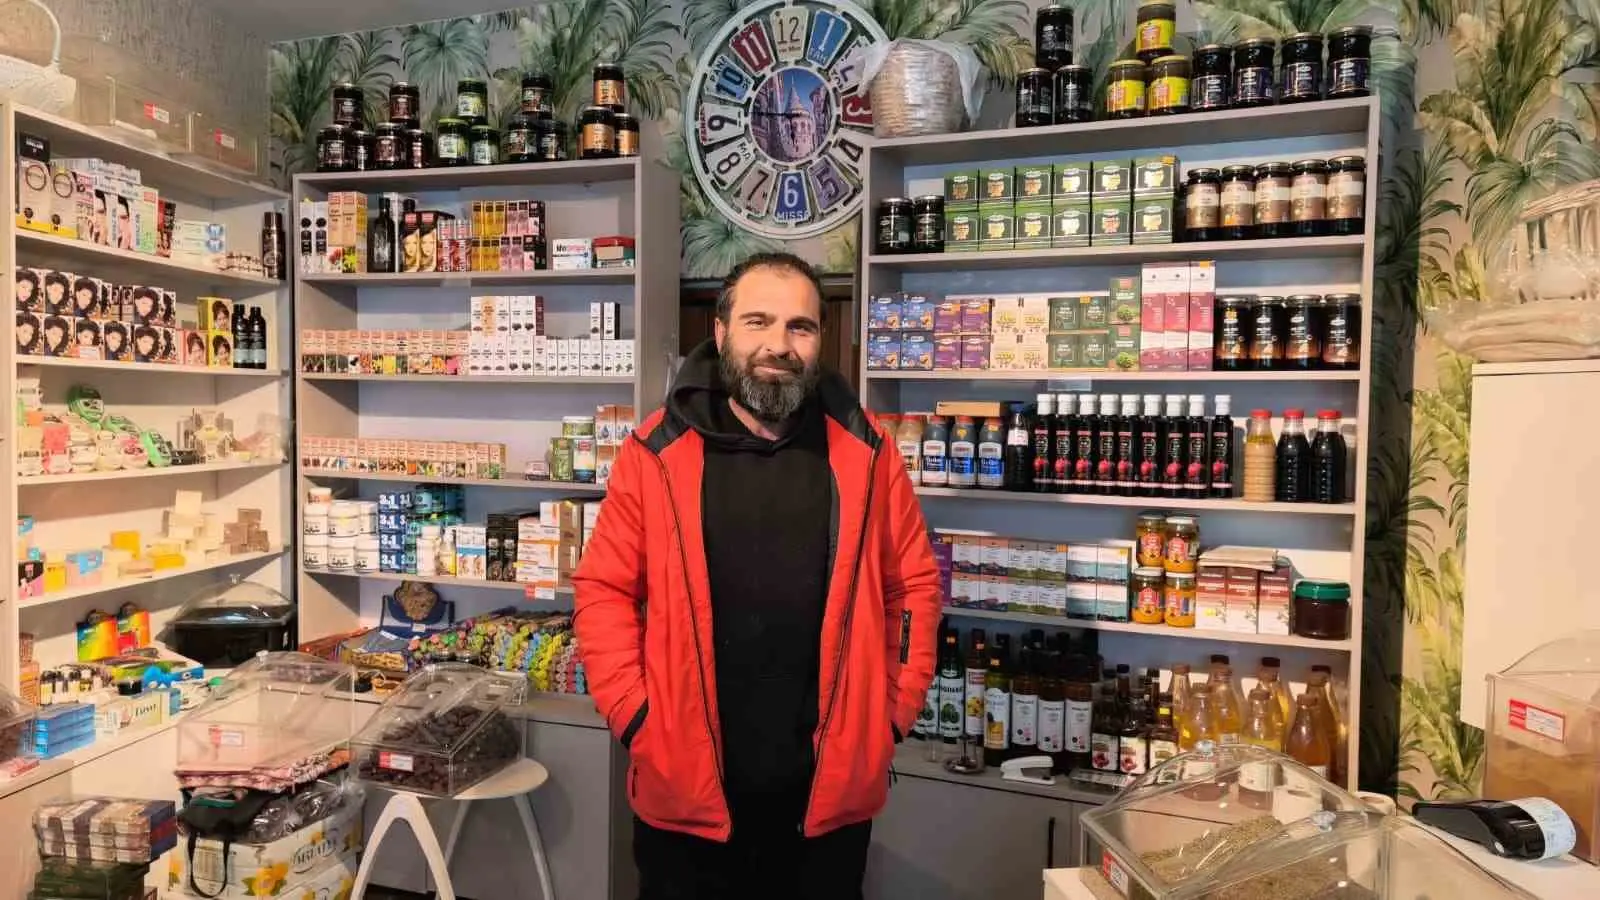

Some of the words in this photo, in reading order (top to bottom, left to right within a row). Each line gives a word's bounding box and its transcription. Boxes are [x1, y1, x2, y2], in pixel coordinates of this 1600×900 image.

[778, 17, 801, 44] 12
[818, 18, 836, 51] 1
[741, 32, 767, 66] 11
[716, 67, 743, 98] 10
[708, 115, 737, 131] 9
[717, 152, 741, 175] 8
[748, 169, 768, 200] 7
[784, 175, 799, 208] 6
[815, 166, 839, 199] 5
